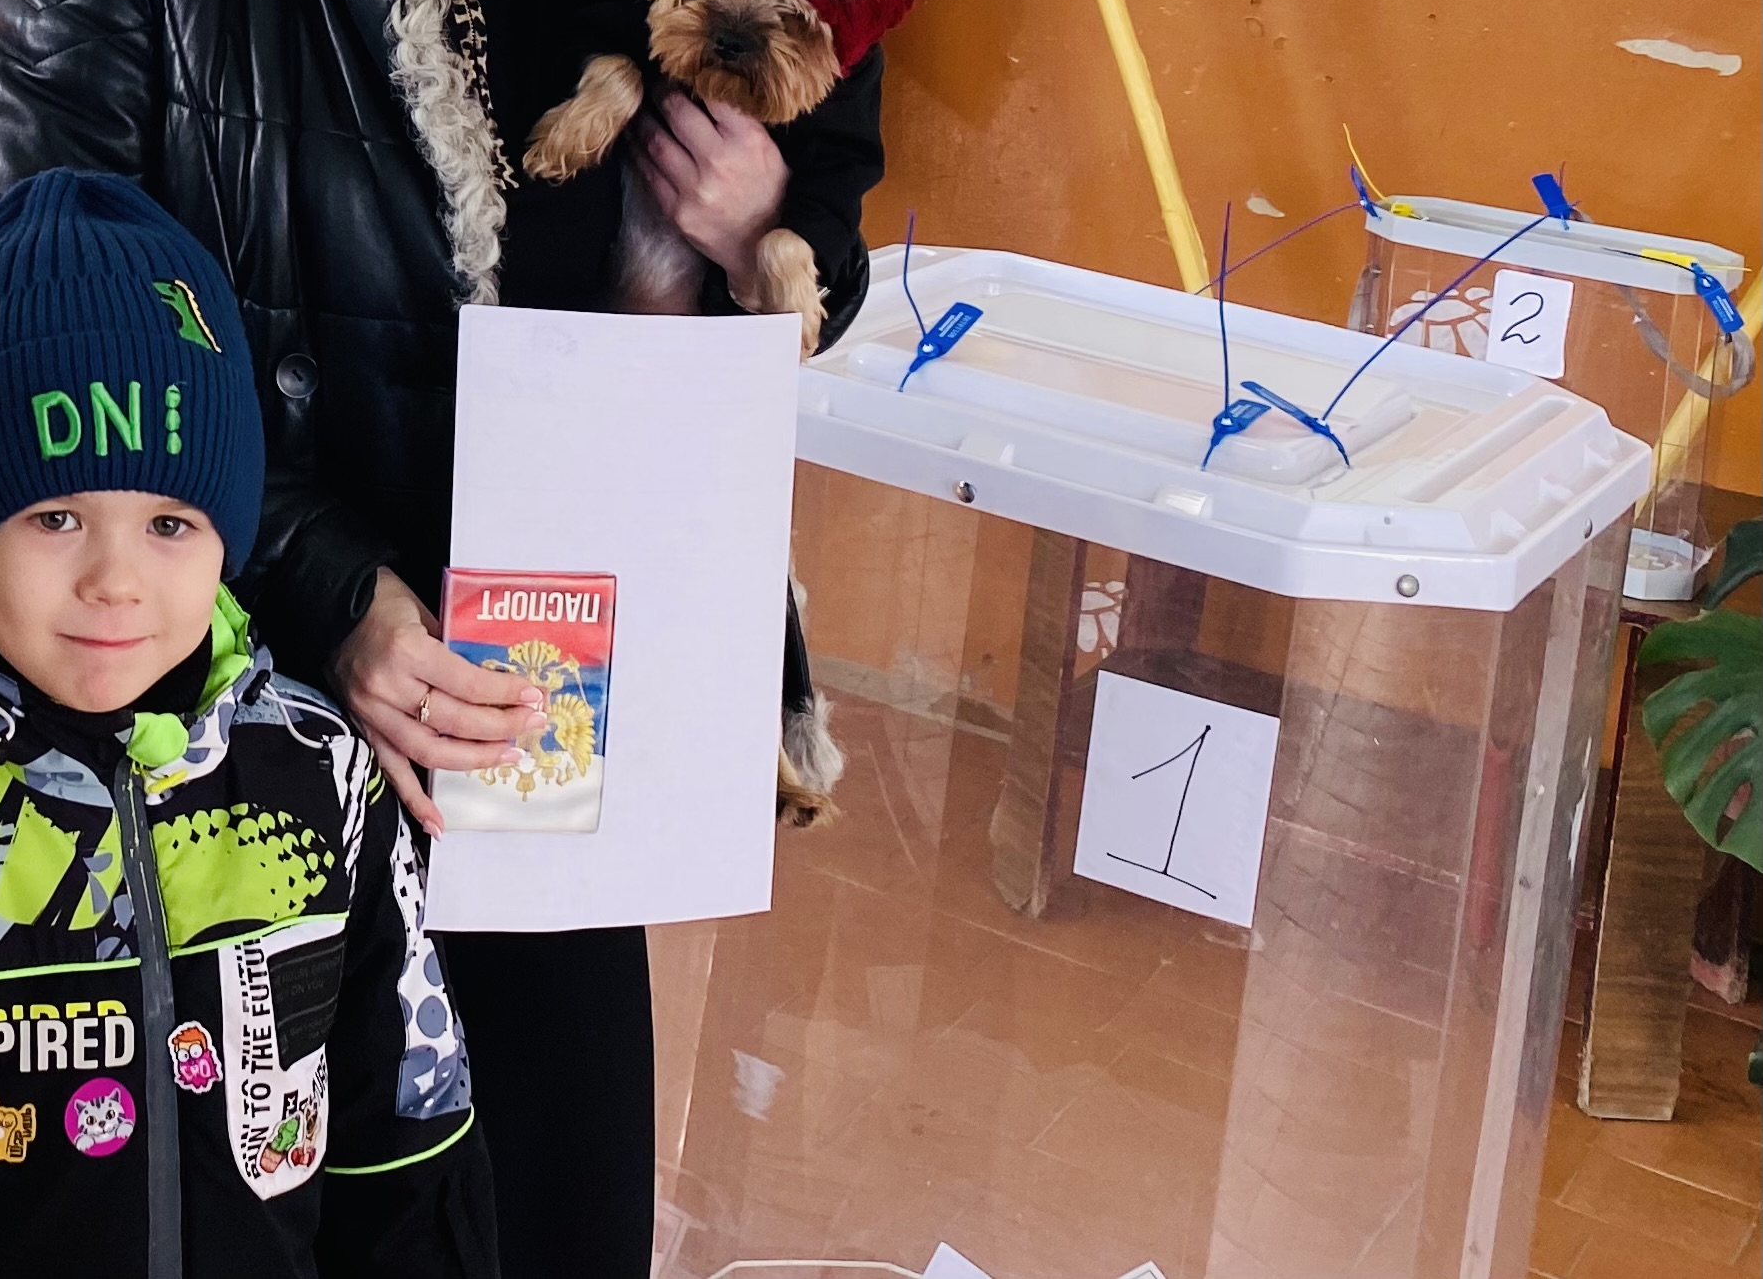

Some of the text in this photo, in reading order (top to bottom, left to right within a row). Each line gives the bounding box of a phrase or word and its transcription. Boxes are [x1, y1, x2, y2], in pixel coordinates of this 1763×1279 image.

[1500, 291, 1541, 345] 2
[476, 589, 601, 624] ПАСПОРТ
[1106, 724, 1218, 900] 1
[249, 1024, 274, 1075] THE
[249, 1082, 272, 1119] TO
